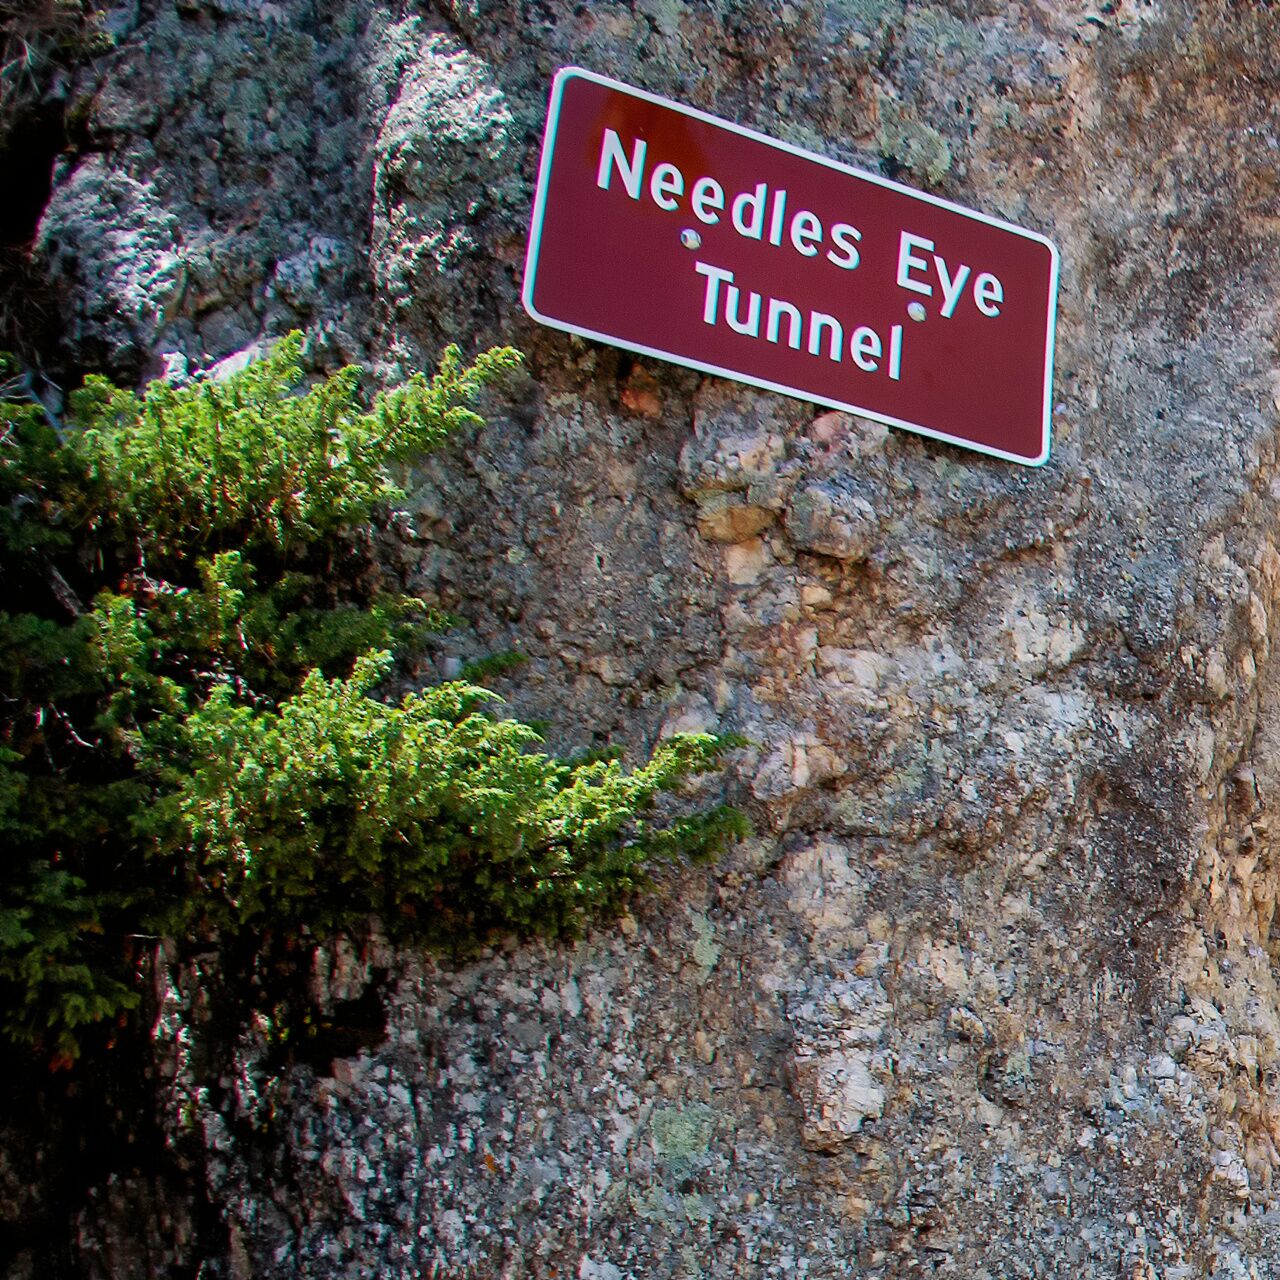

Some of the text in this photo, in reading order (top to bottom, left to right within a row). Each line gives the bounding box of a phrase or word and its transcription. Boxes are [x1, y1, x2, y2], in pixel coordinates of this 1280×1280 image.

[596, 128, 1004, 319] Needles Eye
[694, 261, 903, 381] Tunnel
